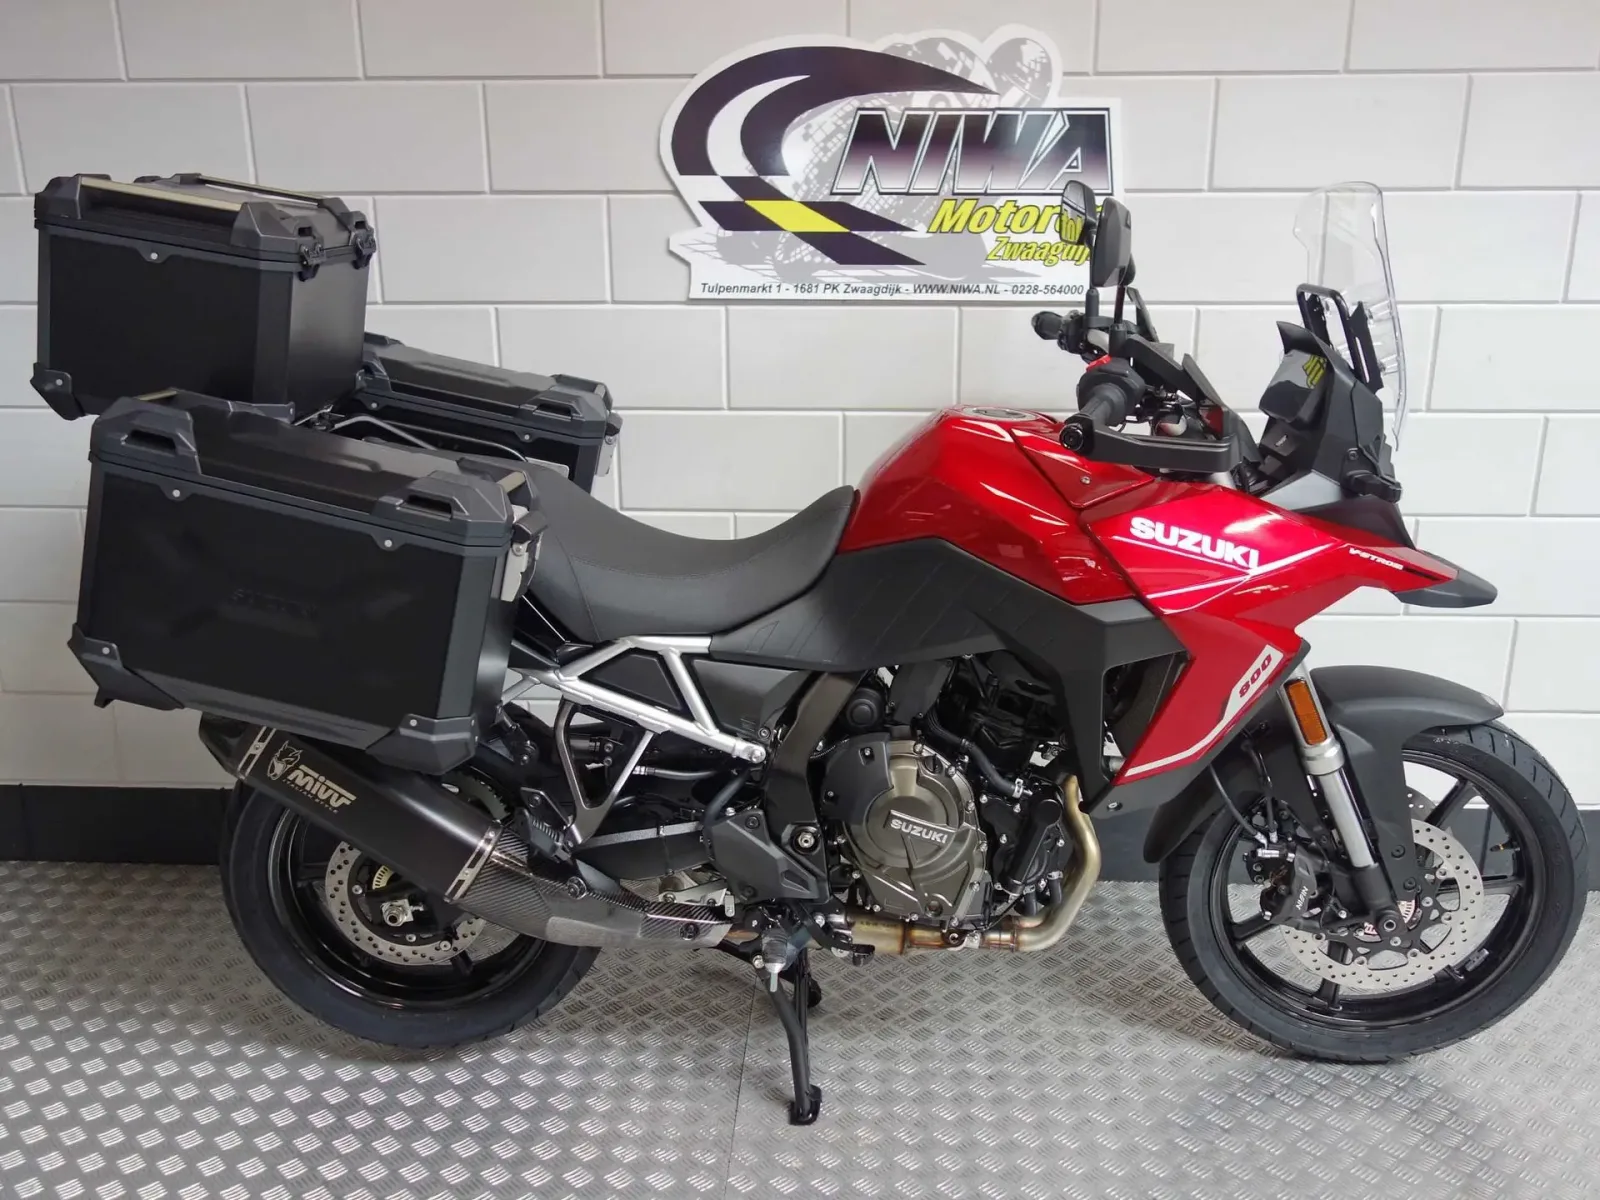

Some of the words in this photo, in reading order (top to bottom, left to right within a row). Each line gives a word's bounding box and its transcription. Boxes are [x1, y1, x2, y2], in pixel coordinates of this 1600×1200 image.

[830, 107, 1114, 196] NIWA
[927, 199, 1102, 233] Motor
[700, 282, 773, 296] Tulpenmarkt
[775, 283, 782, 294] 1
[793, 283, 820, 295] 1681
[822, 283, 840, 294] PK
[843, 283, 902, 297] Zwaagdijk
[913, 283, 1000, 295] WWW.NIWA.NL
[1011, 284, 1084, 296] 0228-564000
[1130, 517, 1260, 569] SUZUKI
[1239, 653, 1272, 697] 800
[890, 819, 948, 843] SUZUKI
